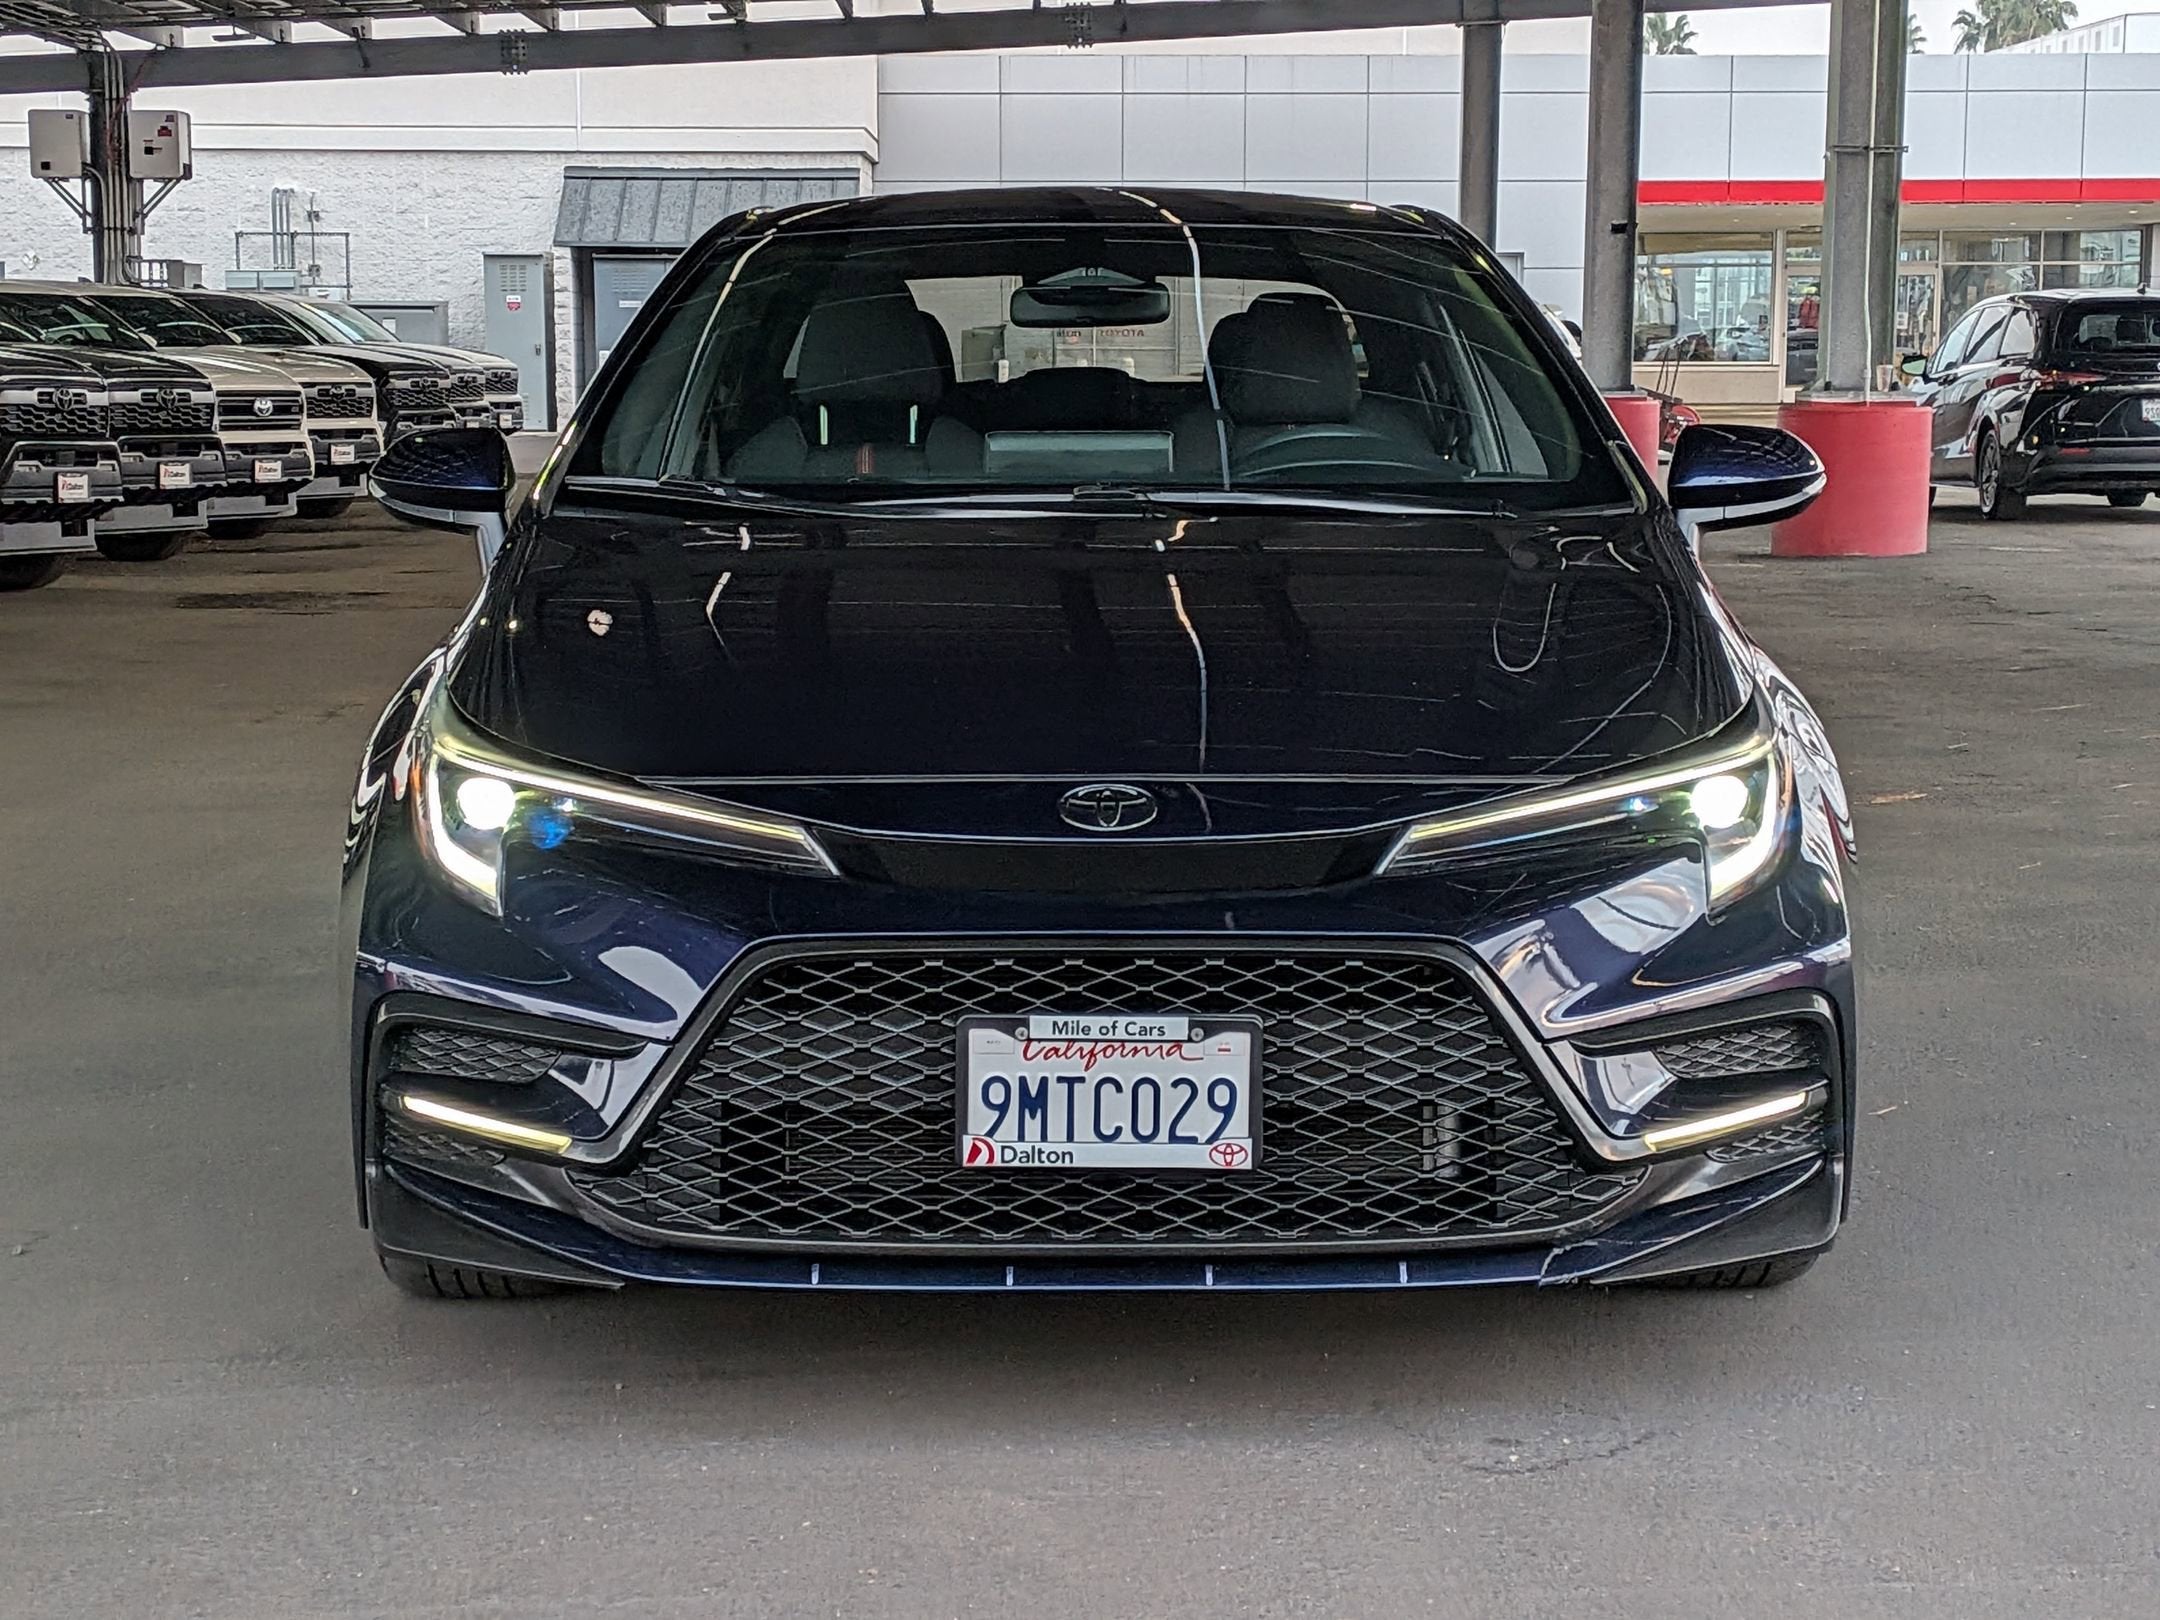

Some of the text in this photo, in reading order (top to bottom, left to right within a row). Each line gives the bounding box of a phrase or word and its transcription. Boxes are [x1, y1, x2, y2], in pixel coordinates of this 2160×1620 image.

[1052, 1020, 1166, 1037] Mile of Cars
[1021, 1040, 1204, 1071] California
[1001, 1146, 1074, 1165] Dalton
